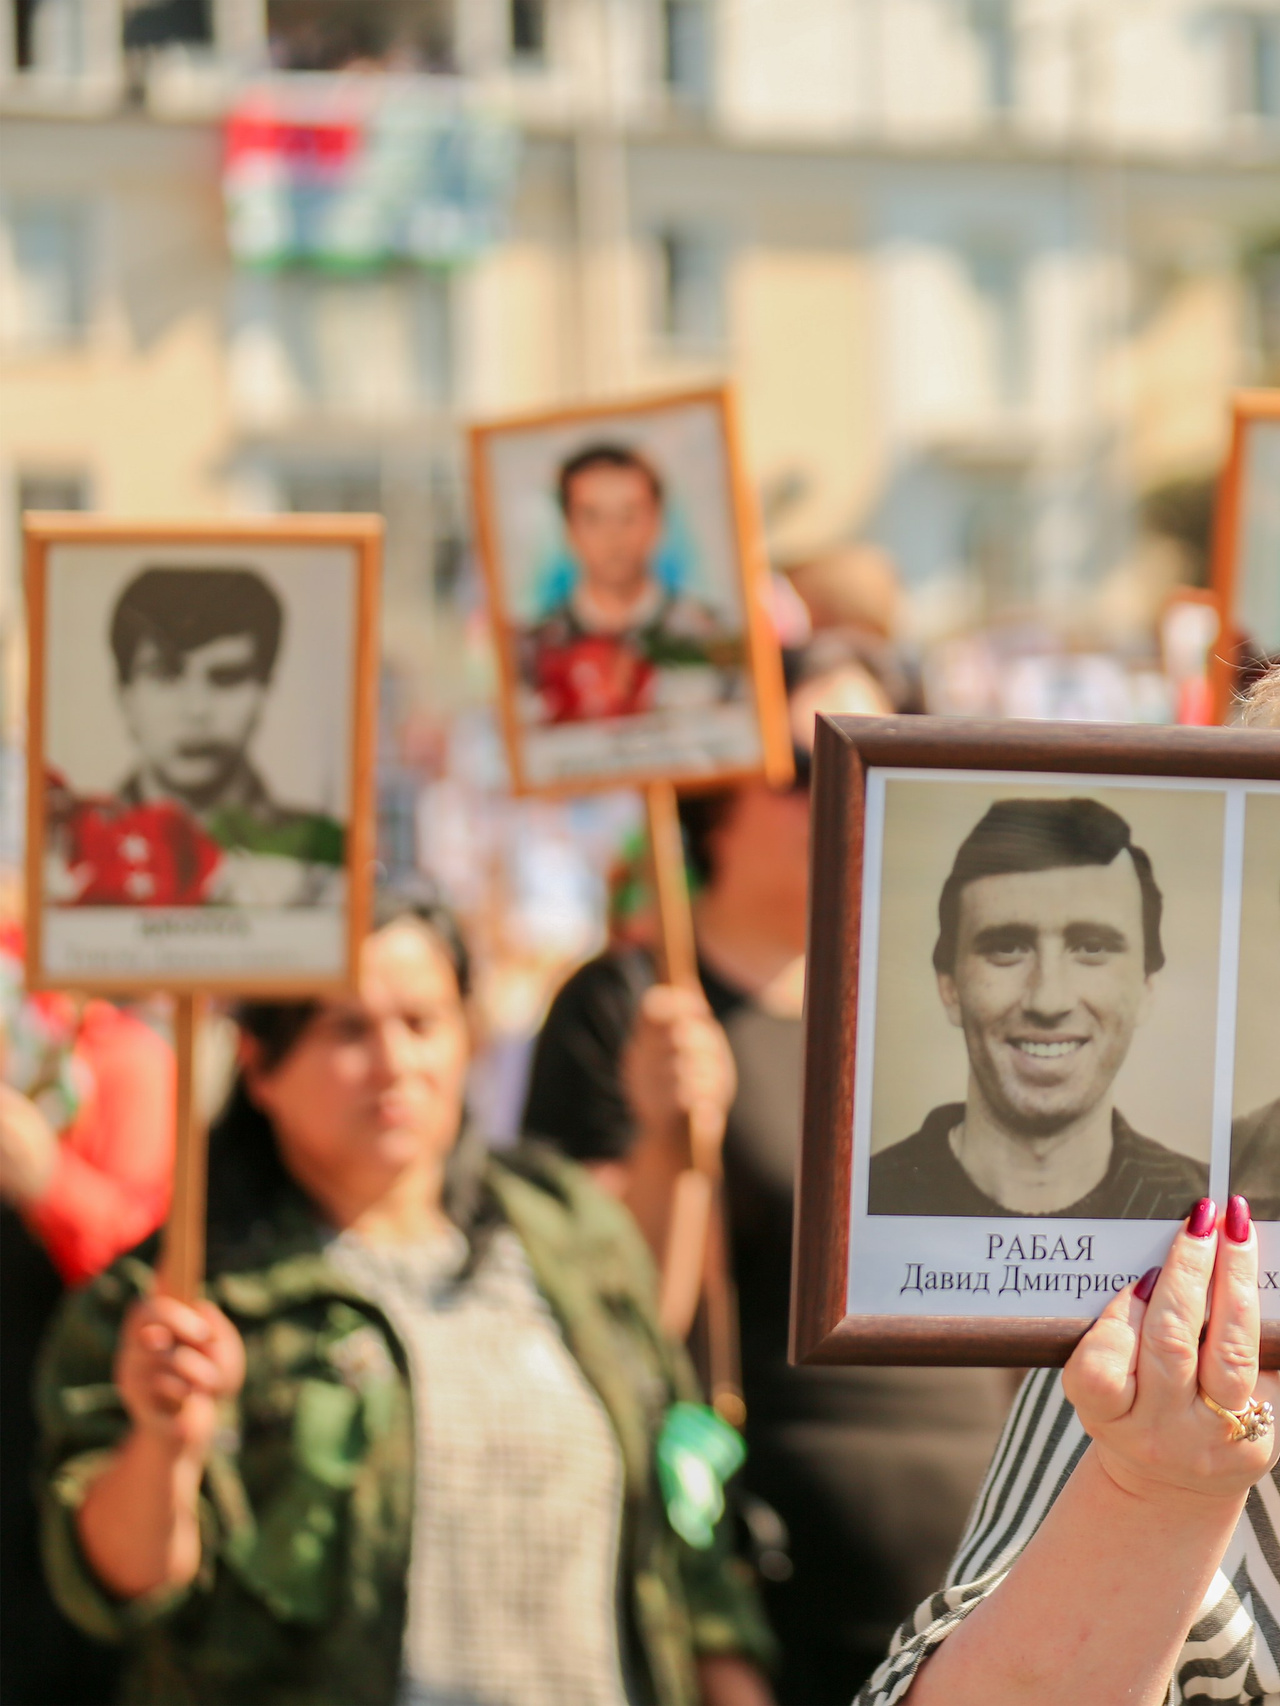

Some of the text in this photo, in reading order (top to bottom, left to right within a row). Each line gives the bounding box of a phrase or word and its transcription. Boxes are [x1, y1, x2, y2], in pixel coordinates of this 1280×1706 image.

[985, 1233, 1096, 1261] РАБАЯ
[899, 1262, 1141, 1300] Давид Дмитрие
